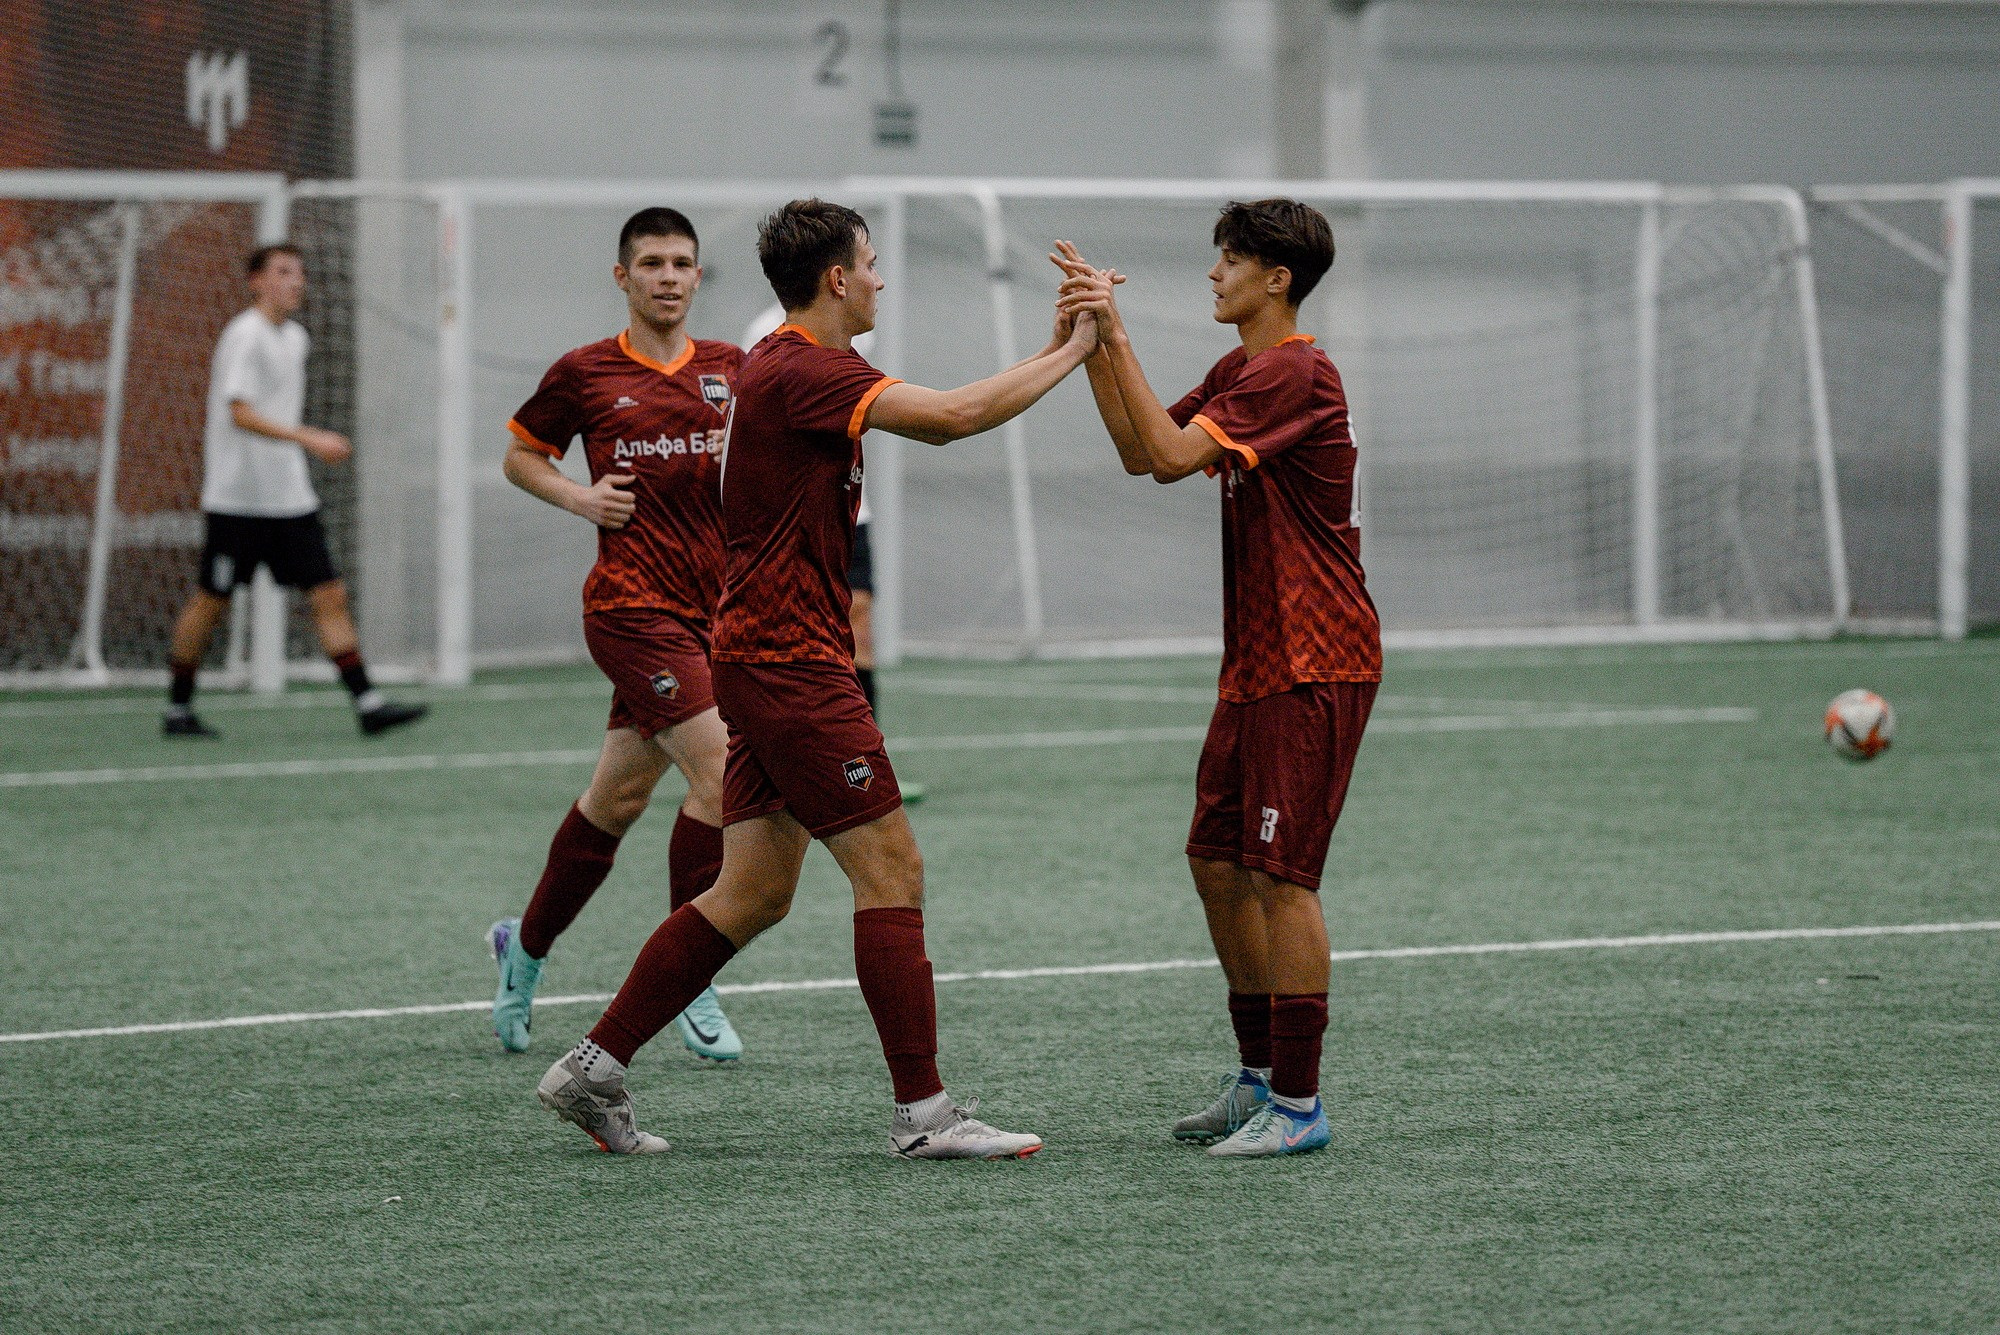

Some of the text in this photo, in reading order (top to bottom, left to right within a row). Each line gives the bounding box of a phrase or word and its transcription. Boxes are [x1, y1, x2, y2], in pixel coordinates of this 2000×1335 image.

[813, 20, 850, 86] 2
[613, 432, 718, 460] Альфа Ба
[847, 766, 871, 783] ТЕМП
